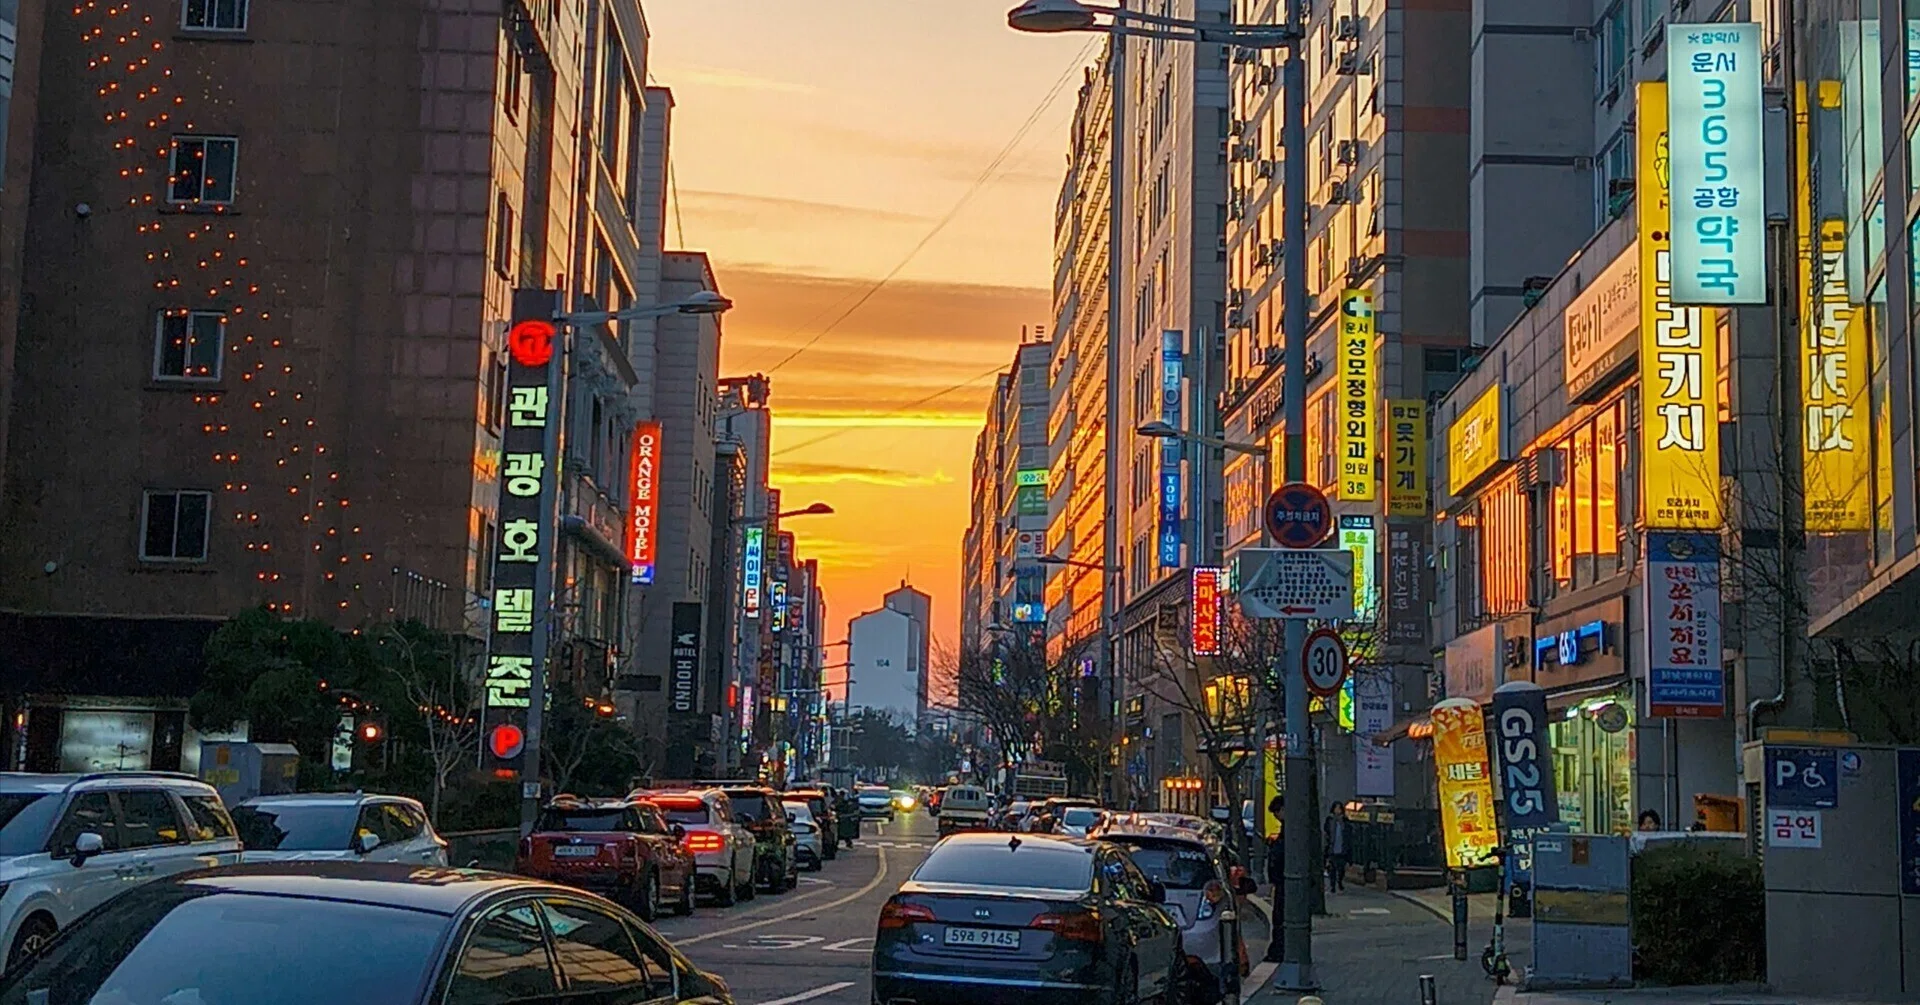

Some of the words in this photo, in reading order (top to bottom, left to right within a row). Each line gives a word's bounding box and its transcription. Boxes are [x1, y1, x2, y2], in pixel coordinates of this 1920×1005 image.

[1691, 52, 1736, 73] 운서
[1702, 79, 1729, 182] 365
[1693, 186, 1740, 209] 공항
[1696, 215, 1739, 297] 약국
[1345, 322, 1369, 334] 운서
[1655, 250, 1705, 451] 리키치
[1346, 338, 1367, 459] 성모정형외과
[637, 435, 654, 500] ORANGE
[1345, 462, 1368, 475] 의원
[1166, 475, 1176, 521] YOUNG
[634, 505, 651, 560] MOTEL
[1164, 523, 1175, 562] JONG
[1199, 585, 1215, 640] 마사지
[673, 648, 697, 657] HOTEL
[1313, 646, 1338, 677] 30
[675, 660, 693, 711] HOUND
[494, 725, 521, 756] P
[1501, 707, 1544, 816] GS25
[1776, 760, 1796, 787] P
[1773, 815, 1817, 839] 금연
[981, 931, 1013, 945] 9145
